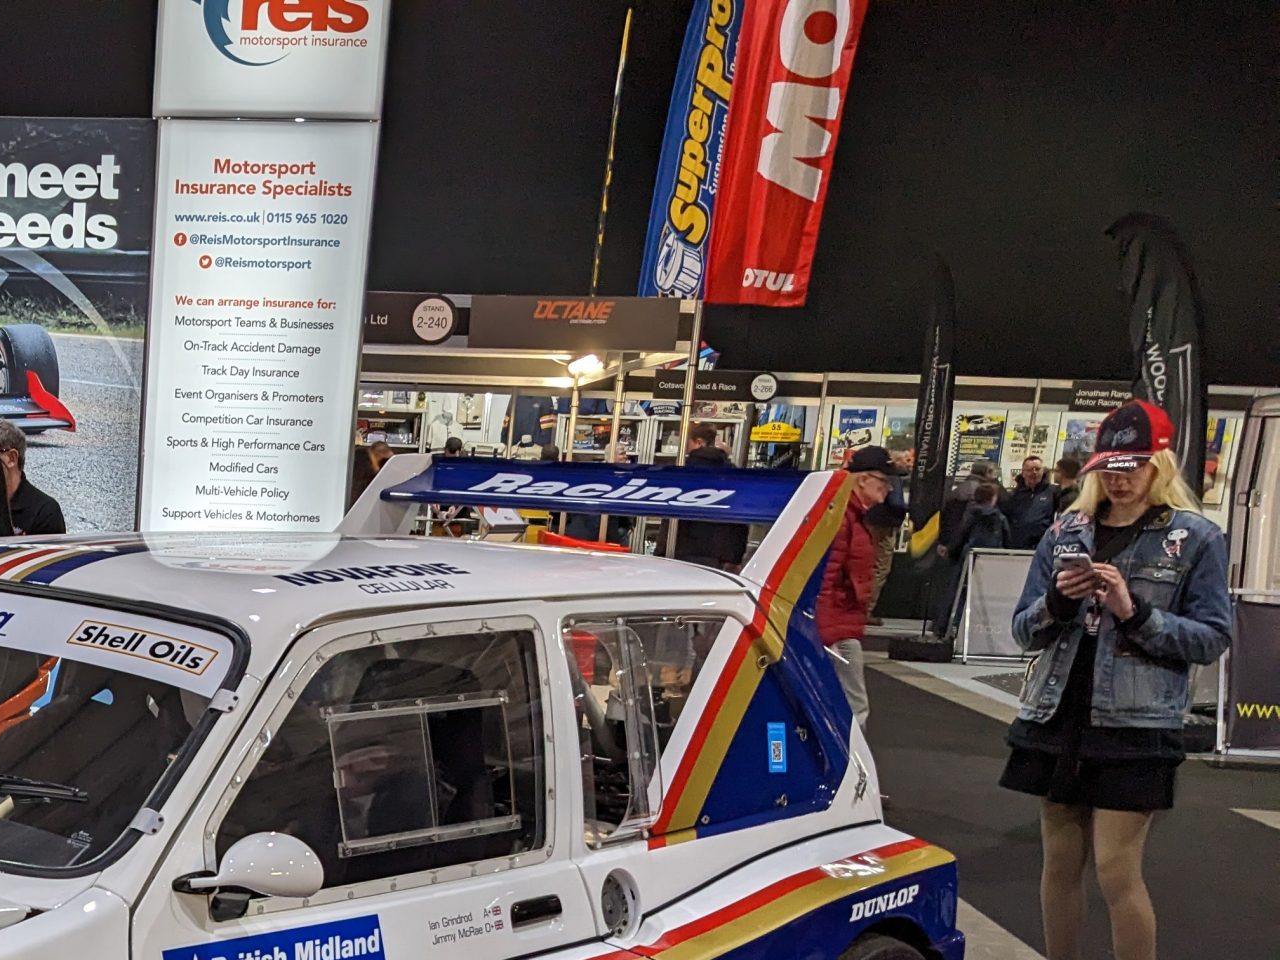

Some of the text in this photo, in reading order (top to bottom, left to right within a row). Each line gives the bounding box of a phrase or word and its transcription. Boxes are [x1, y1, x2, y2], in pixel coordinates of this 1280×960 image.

[240, 35, 368, 49] motorsport insurance
[214, 159, 316, 179] Motorsport
[175, 179, 352, 199] Insurance Specialists
[175, 212, 347, 225] www.reis.co.uk 0115 965 1020
[190, 234, 340, 248] @ReisMotorsportInsurance
[215, 257, 311, 271] @Reismotorsport
[742, 268, 794, 292] OTUL
[175, 296, 336, 310] We can arrange insurance for:
[534, 301, 615, 320] OCTANE
[175, 316, 334, 330] Motorsport Teams & Businesses
[370, 314, 387, 324] Ltd
[417, 317, 447, 329] 2-240
[184, 341, 321, 356] On-Track Accident Damage
[202, 366, 299, 379] Track Day Insurance
[175, 389, 324, 403] Event Organisers & Promoters
[1076, 390, 1110, 398] Jonathan
[182, 413, 313, 427] Competition Car Insurance
[167, 437, 325, 451] Sports & High Performance Cars
[210, 462, 278, 474] Modified Cars
[195, 486, 289, 500] Multi-Vehicle Policy
[468, 472, 736, 506] Racing
[162, 508, 320, 523] Support Vehicles & Motorhomes
[272, 563, 470, 587] NOVAFONE
[358, 579, 455, 594] CELLULAR
[76, 624, 146, 653] Shell
[149, 640, 204, 670] Oils
[849, 883, 919, 923] DUNLOP
[428, 920, 440, 930] Ian
[432, 926, 483, 945] Jimmy McRae
